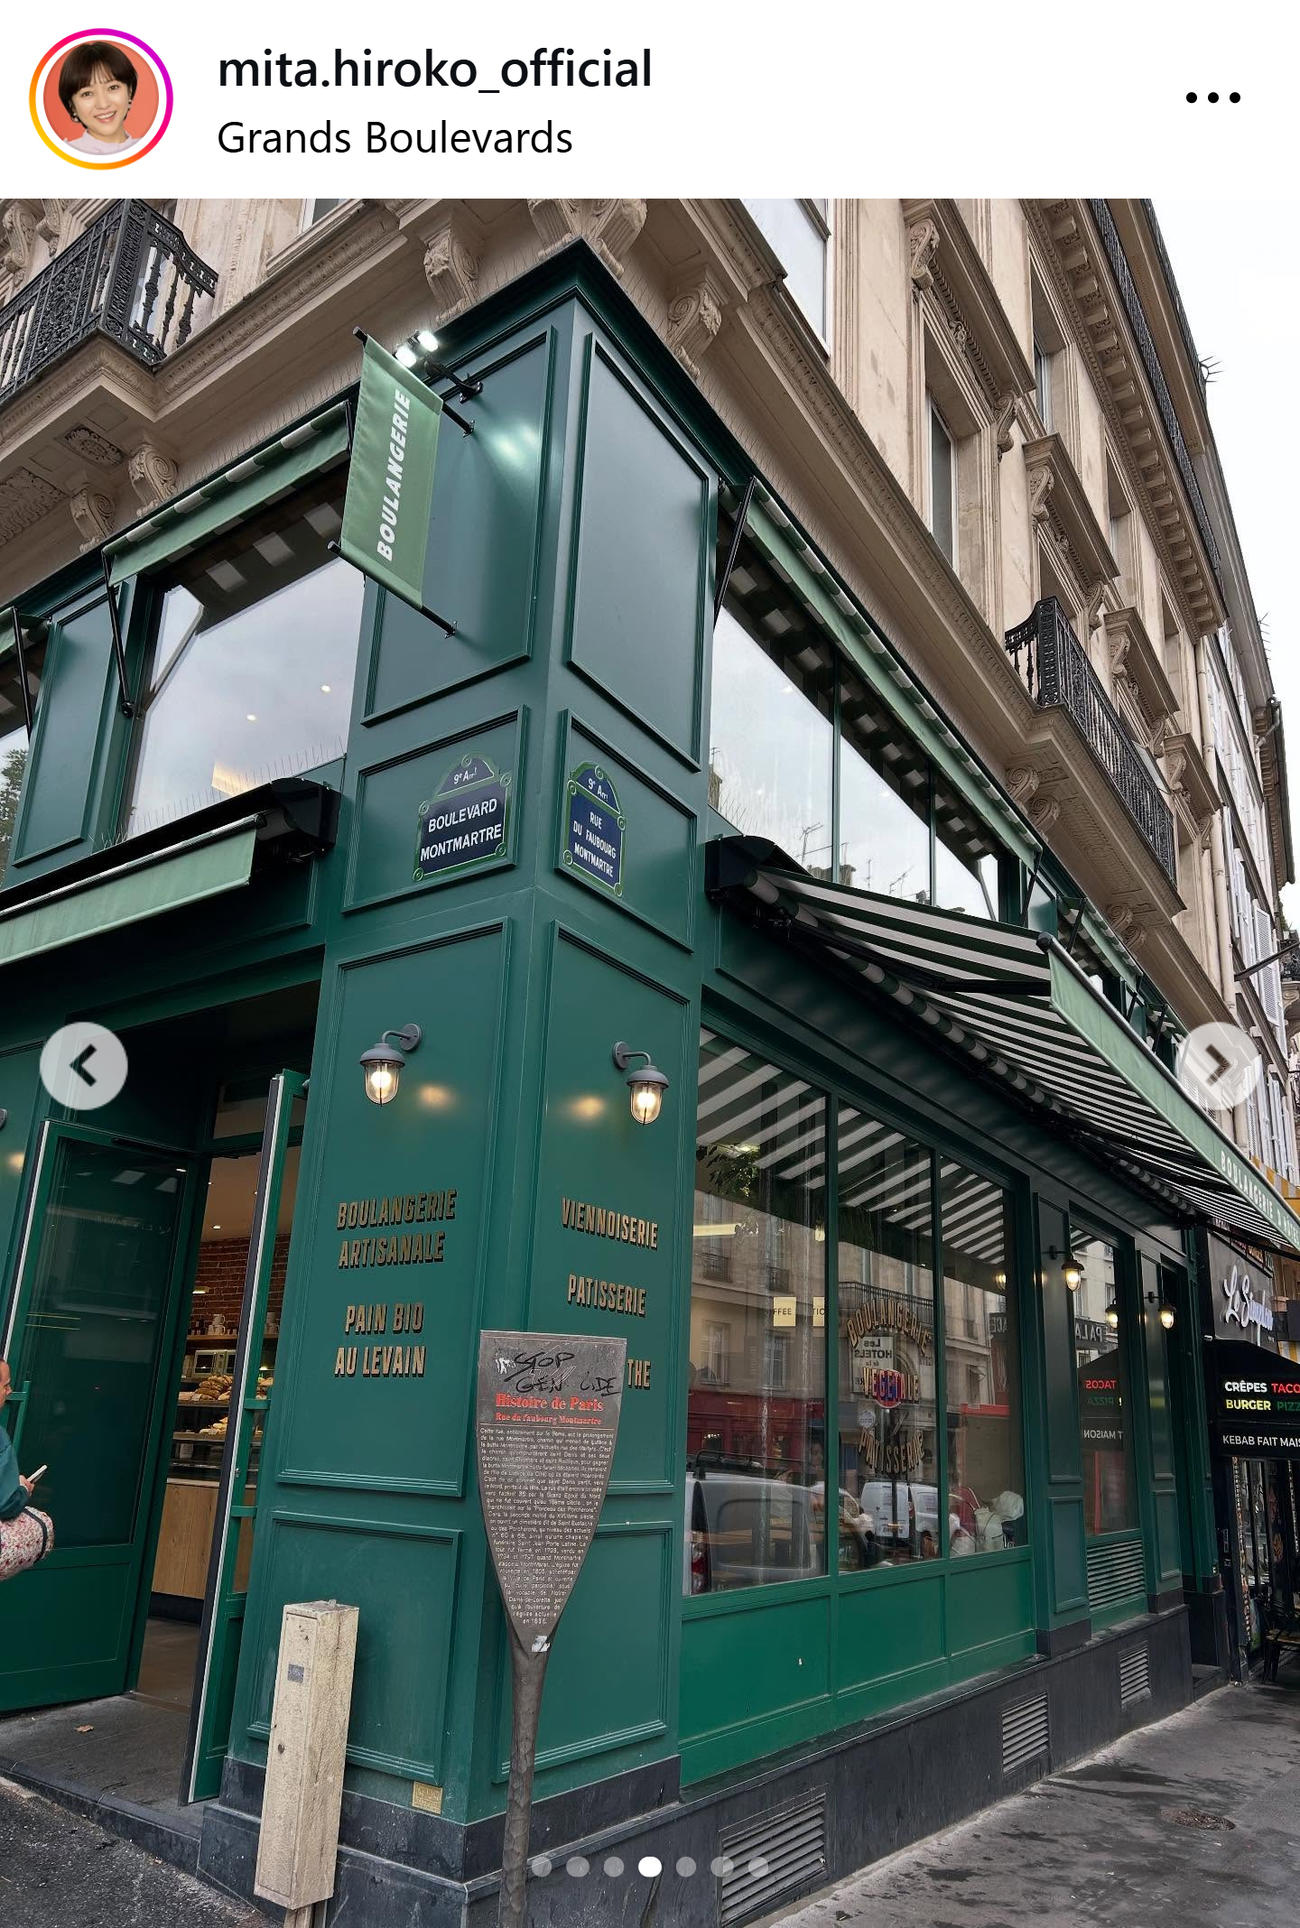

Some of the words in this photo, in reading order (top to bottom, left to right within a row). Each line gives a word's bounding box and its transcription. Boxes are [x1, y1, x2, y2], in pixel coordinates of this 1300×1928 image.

[377, 390, 411, 561] BOULANGERIE
[428, 798, 497, 833] BOULEVARD
[590, 811, 602, 830] RUE
[420, 824, 501, 862] MONTMARTRE
[573, 821, 582, 836] DU
[586, 832, 616, 859] FAUBOURG
[575, 842, 613, 878] MONTMARTRE
[337, 1188, 457, 1230] BOULANGERIE
[562, 1197, 658, 1250] VIENNOISERIE
[338, 1231, 445, 1269] ARTISANALE
[567, 1274, 646, 1317] PATISSERIE
[344, 1304, 387, 1335] PAIN
[393, 1302, 424, 1333] BIO
[847, 1299, 929, 1356] BOULANGERIE
[334, 1347, 358, 1378] AU
[362, 1346, 426, 1378] LEVAIN
[504, 1351, 575, 1382] STOP
[627, 1359, 650, 1390] THE
[496, 1392, 547, 1408] Histoire
[552, 1397, 566, 1410] de
[570, 1396, 604, 1411] Paris
[1225, 1380, 1267, 1392] CRÊPES
[496, 1412, 510, 1420] Rue
[511, 1413, 520, 1421] du
[559, 1415, 602, 1425] Montmartre
[1226, 1400, 1271, 1410] BURGER
[1223, 1435, 1255, 1445] KEBAB
[1257, 1436, 1278, 1446] FAIT
